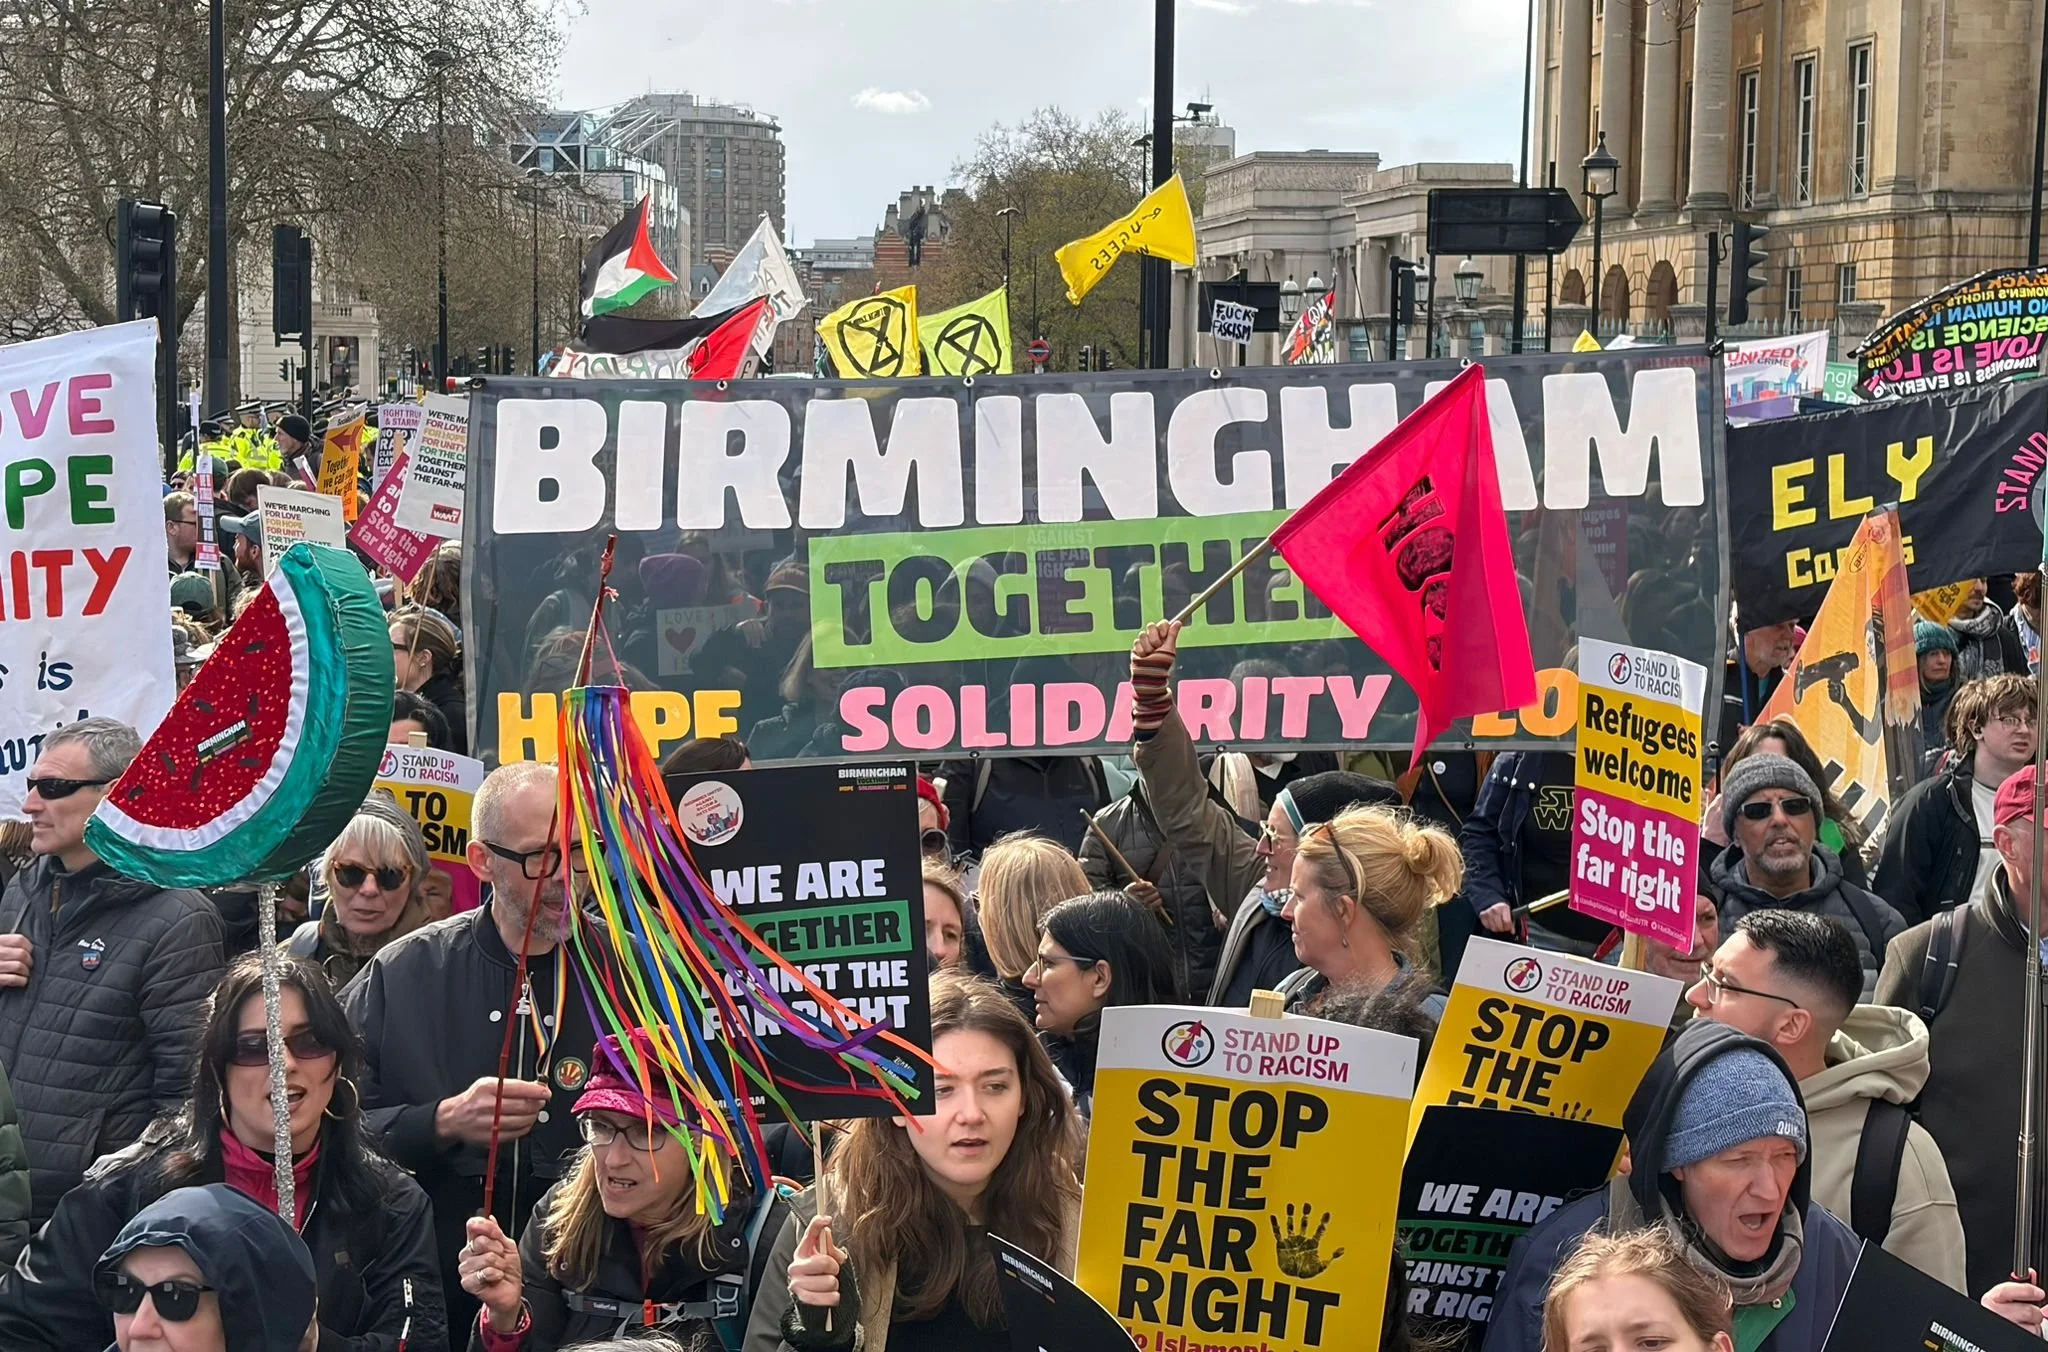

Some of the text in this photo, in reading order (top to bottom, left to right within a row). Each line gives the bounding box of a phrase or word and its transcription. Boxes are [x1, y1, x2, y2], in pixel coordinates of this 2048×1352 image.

[1213, 320, 1251, 342] FASCISM
[1728, 348, 1795, 361] UNITED
[0, 373, 116, 440] VE
[422, 437, 440, 446] FOR
[426, 419, 467, 434] FOR LOVE
[420, 445, 437, 455] FOR
[413, 473, 431, 484] THE
[415, 464, 456, 479] AGAINST
[1772, 435, 1934, 531] ELY
[1995, 431, 2048, 513] STAND
[264, 501, 331, 517] WE'RE MARCHING
[265, 510, 301, 521] FOR LOVE
[377, 498, 392, 514] to
[267, 527, 306, 539] FOR UNITY
[267, 535, 282, 543] FOR
[357, 525, 379, 547] far
[376, 543, 408, 572] right
[368, 510, 398, 542] Stop
[398, 530, 418, 557] the
[0, 546, 133, 621] ITY
[37, 651, 75, 691] is
[1635, 656, 1668, 678] STAND
[1634, 673, 1682, 699] TO RACIS
[197, 720, 246, 753] BIRMINGHAM
[497, 690, 742, 765] HPE
[1585, 693, 1698, 760] Refugees
[402, 754, 455, 770] STAND UP
[402, 768, 460, 785] TO RACISM
[838, 767, 907, 779] BIRMINGHAM
[1583, 747, 1692, 804] welcome
[1580, 798, 1636, 857] Stop
[1642, 819, 1685, 867] the
[710, 858, 887, 906] WE ARE
[1577, 843, 1681, 914] far right
[702, 910, 902, 961] GETHER
[848, 960, 909, 989] THE
[1550, 966, 1630, 996] STAND UP
[1546, 983, 1632, 1015] TO RACISM
[1224, 1027, 1340, 1057] STAND UP
[1471, 997, 1611, 1064] STOP
[1223, 1050, 1349, 1084] TO RACISM
[1461, 1043, 1563, 1107] THE
[1135, 1078, 1329, 1149] STOP
[1131, 1140, 1271, 1210] THE
[1417, 1182, 1564, 1224] WE ARE
[1123, 1202, 1257, 1273] FAR
[1001, 1252, 1054, 1291] BIRMINGHAM
[1117, 1264, 1341, 1347] RIGHT
